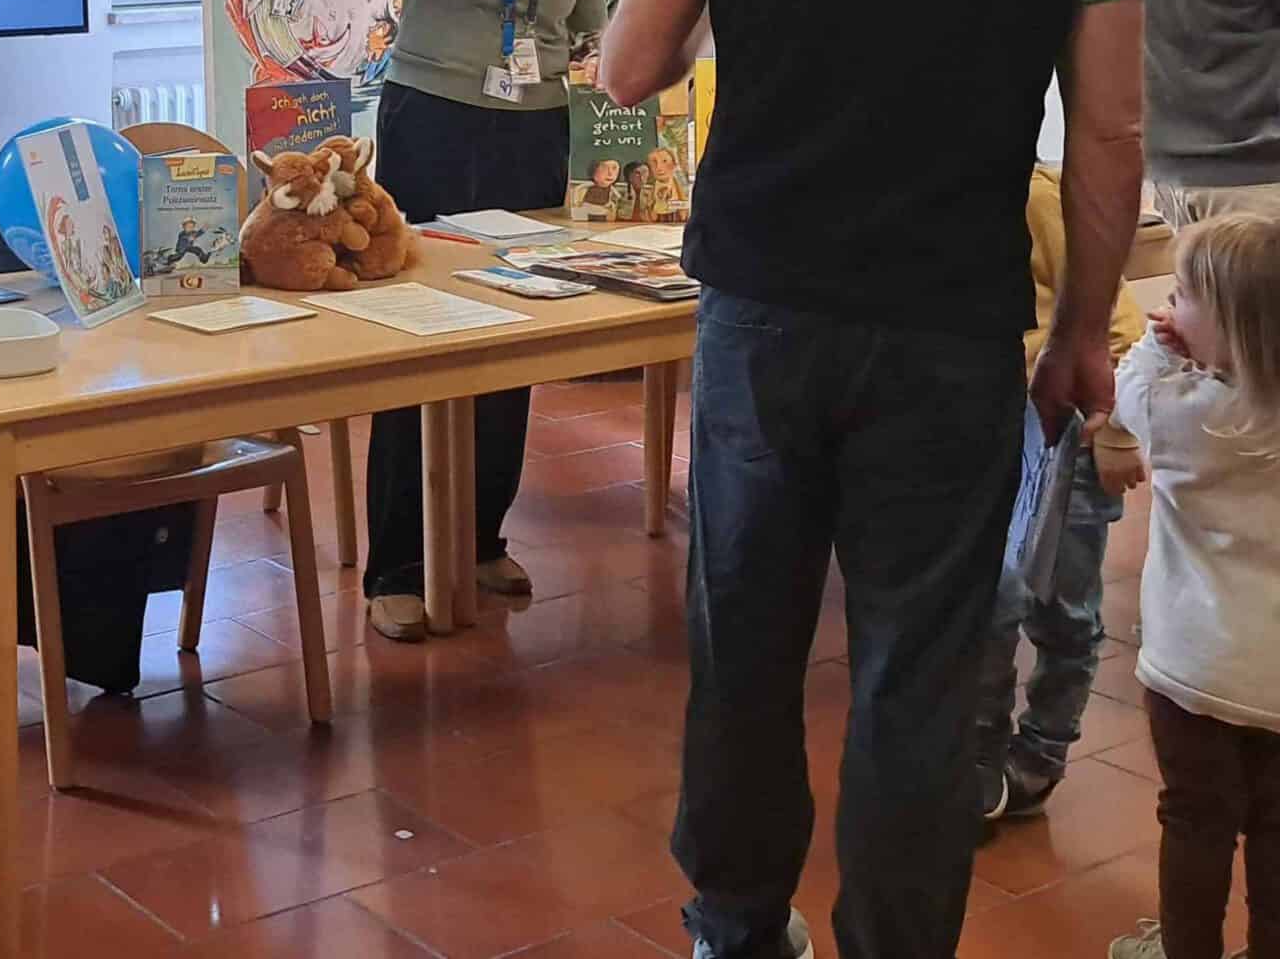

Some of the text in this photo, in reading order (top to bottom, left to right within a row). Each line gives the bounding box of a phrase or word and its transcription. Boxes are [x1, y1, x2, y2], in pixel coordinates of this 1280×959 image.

[296, 101, 337, 126] nicht
[590, 100, 647, 118] Vimala
[592, 119, 644, 136] gehört
[593, 136, 643, 147] zu uns
